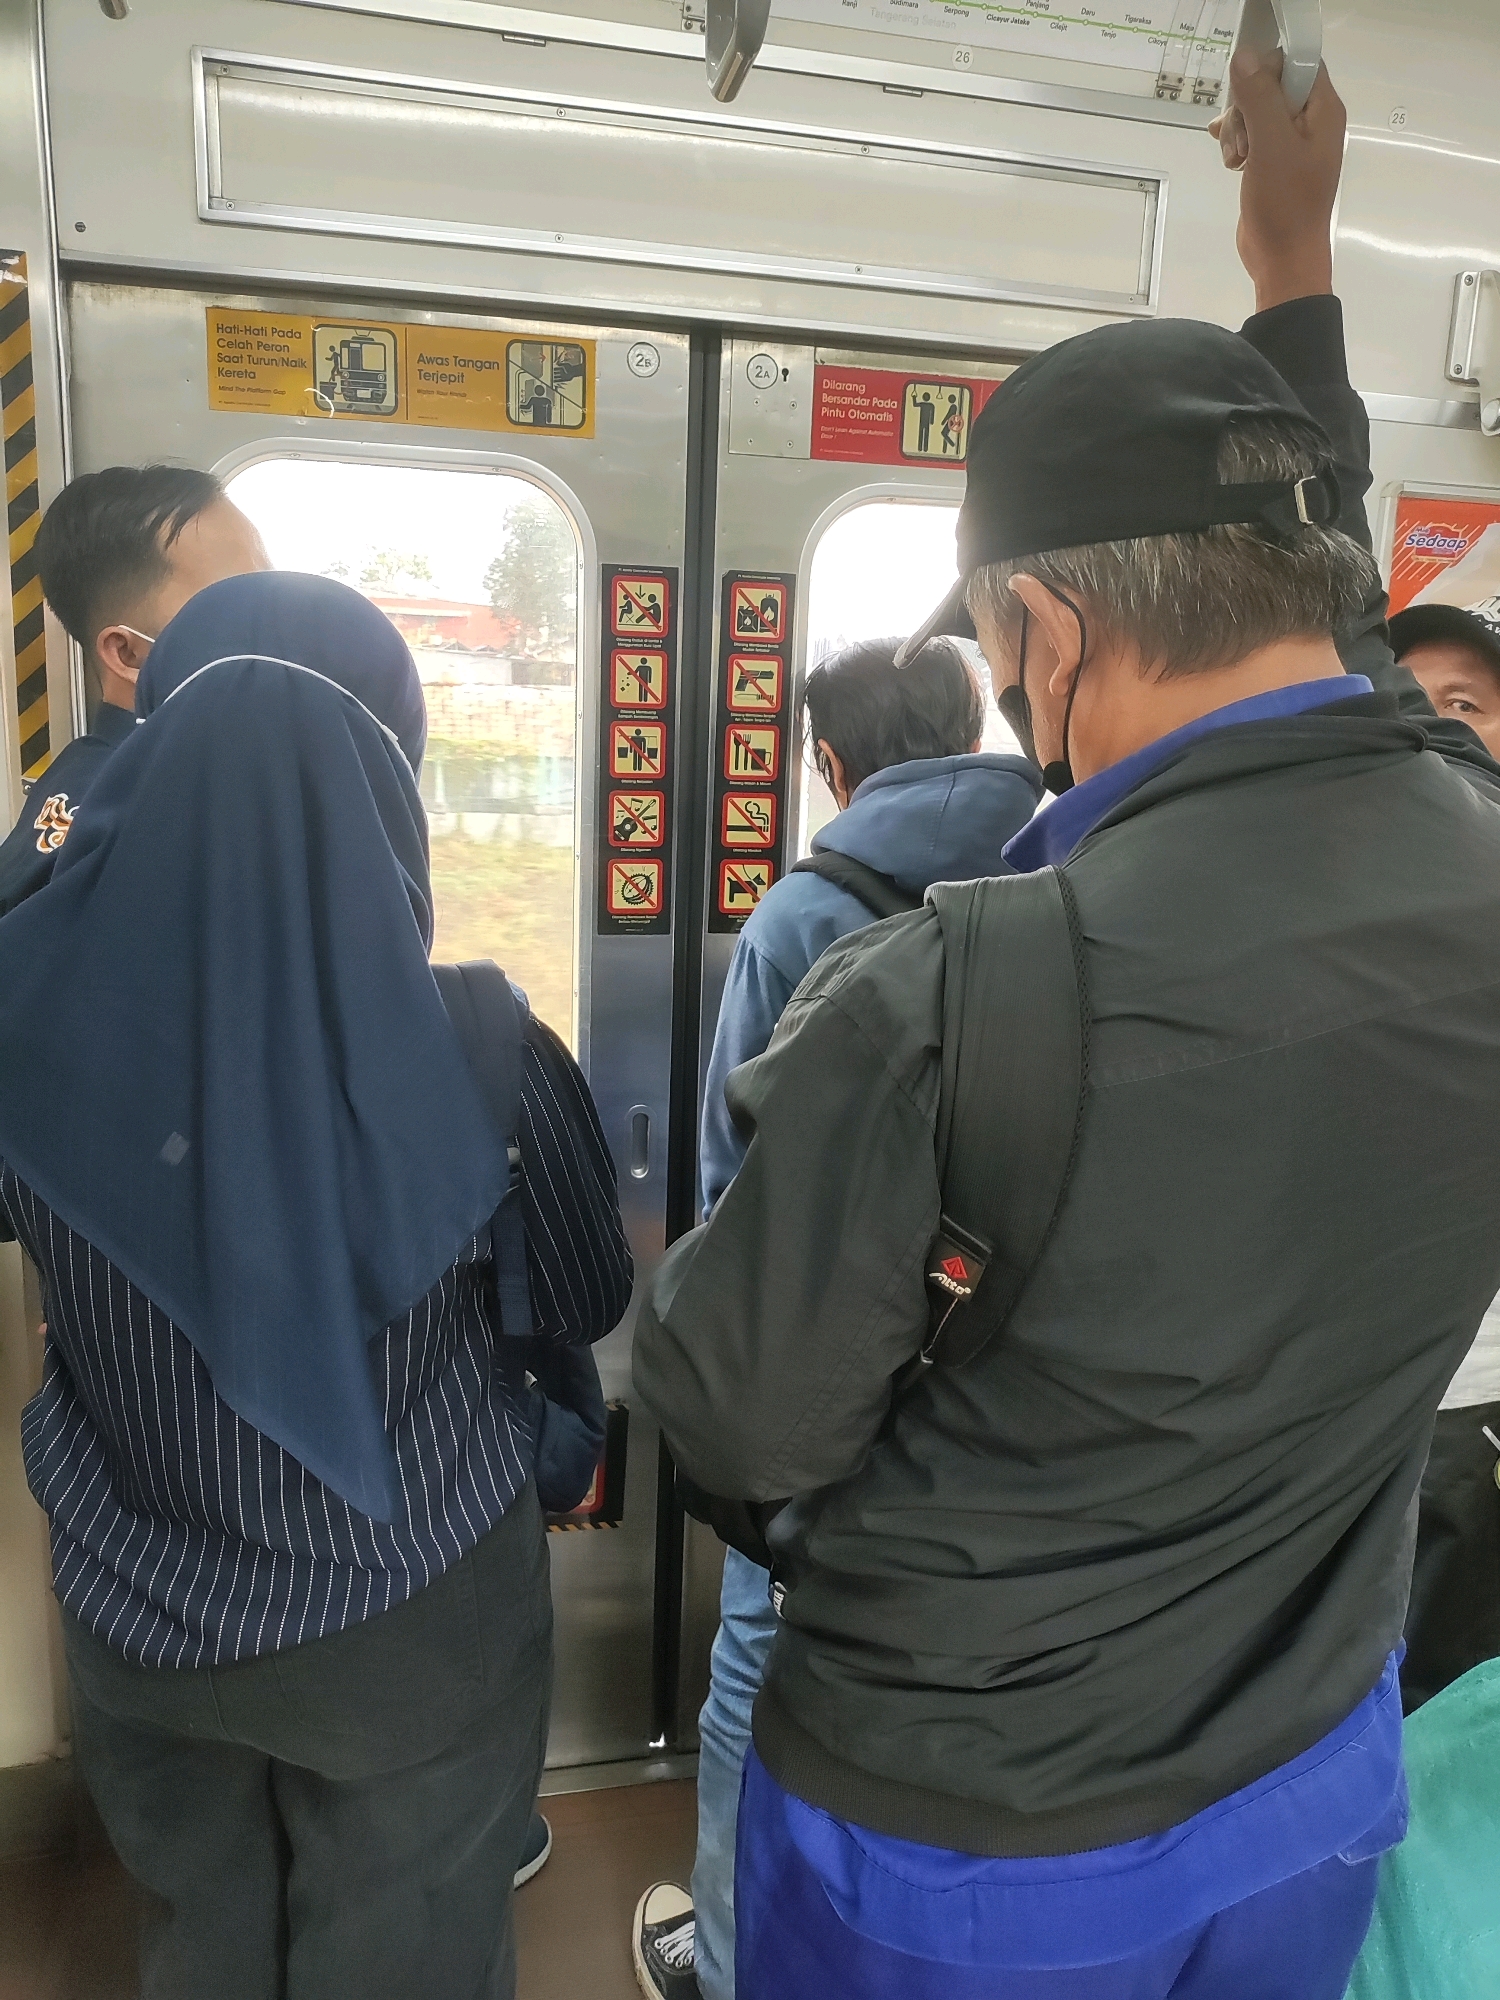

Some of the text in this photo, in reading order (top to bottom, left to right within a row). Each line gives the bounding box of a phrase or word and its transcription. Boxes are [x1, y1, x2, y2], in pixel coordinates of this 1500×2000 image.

[943, 5, 970, 17] Serpong
[1081, 7, 1096, 17] Daru
[1101, 29, 1117, 39] Tenjo
[955, 51, 970, 63] 26
[1392, 112, 1406, 124] 25
[216, 323, 302, 339] Hati-Hati Pada
[216, 337, 290, 353] Celah Peron
[217, 352, 307, 368] Saat Turun/Naik
[417, 353, 500, 372] Awas Tangan
[635, 353, 652, 368] 2B
[217, 366, 256, 379] Kereta
[417, 368, 465, 385] Terjepit
[755, 365, 770, 379] 2A
[822, 379, 866, 395] Dilarang
[822, 392, 898, 409] Bersandar Pada
[821, 406, 893, 422] Pintu Otomatis
[1404, 533, 1468, 552] Sedaap
